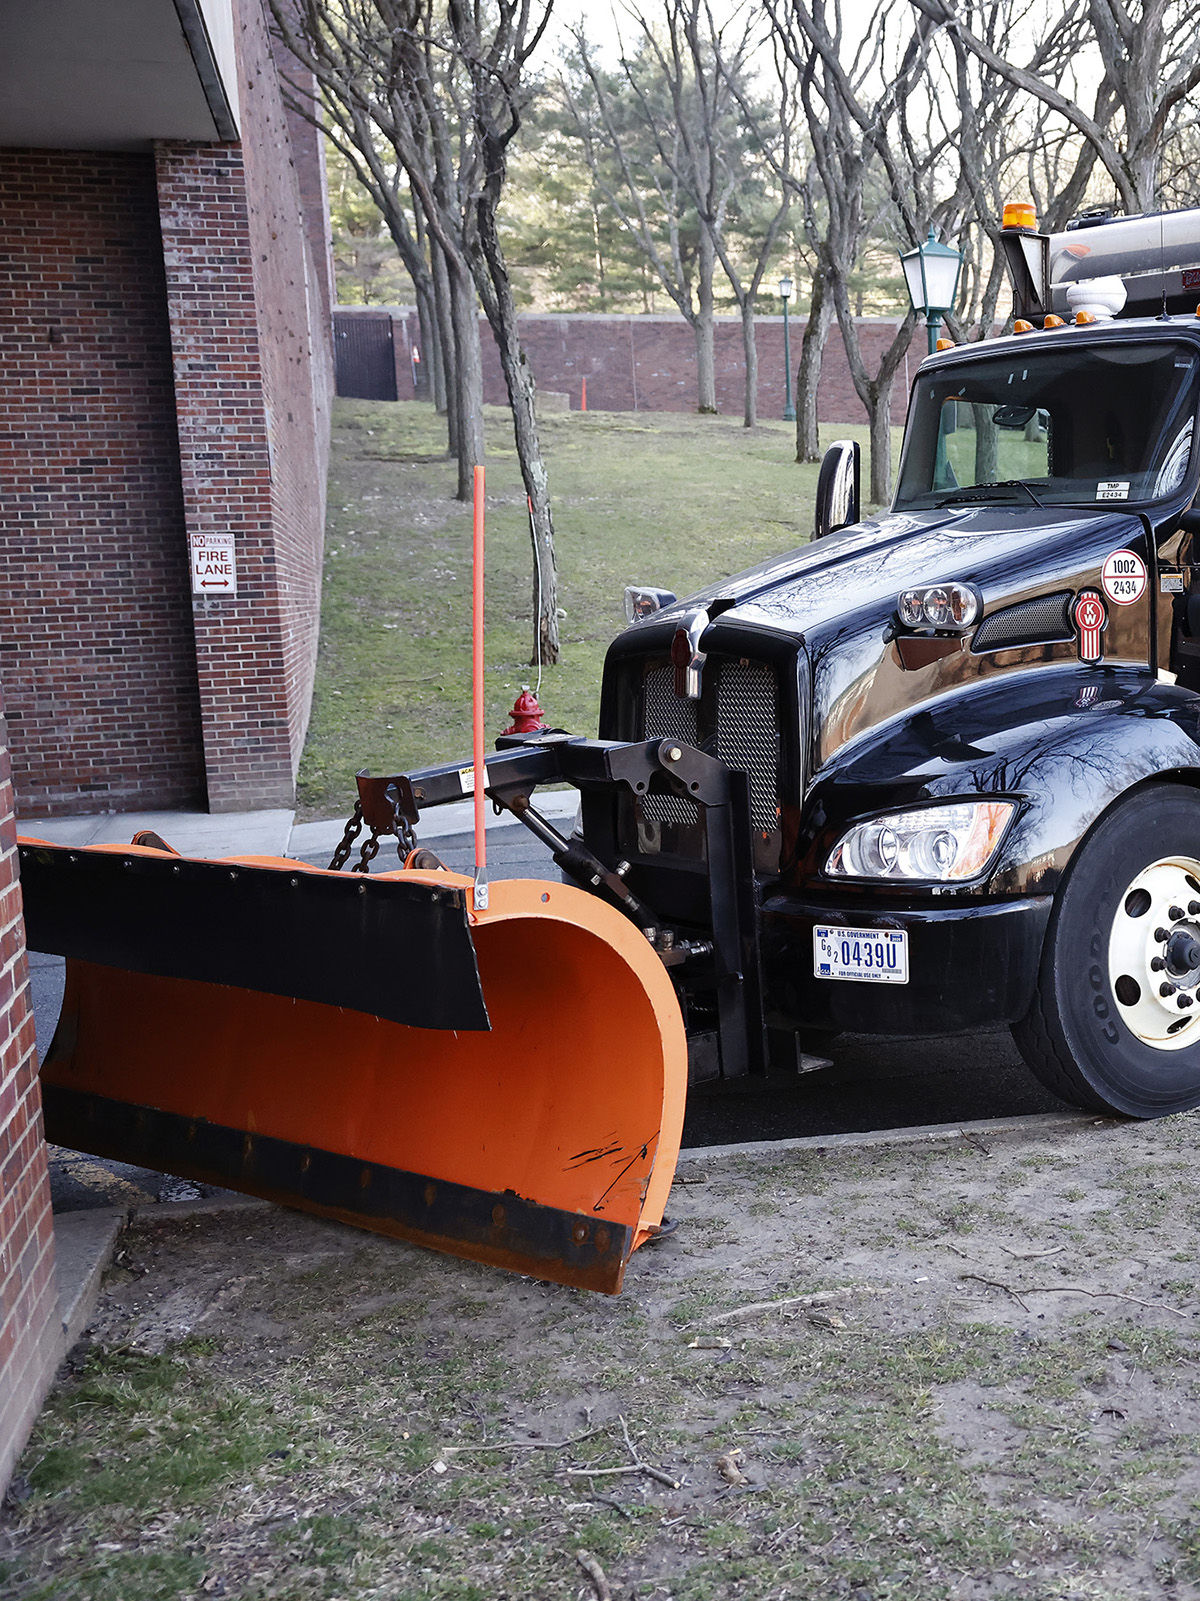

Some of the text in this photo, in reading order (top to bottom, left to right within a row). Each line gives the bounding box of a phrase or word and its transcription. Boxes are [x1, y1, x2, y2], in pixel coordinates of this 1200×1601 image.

[193, 535, 232, 546] NO PARKING
[198, 551, 228, 561] FIRE
[195, 564, 232, 575] LANE
[1113, 560, 1136, 574] 1002
[1113, 581, 1137, 595] 2434
[837, 930, 847, 938] U.S.
[847, 931, 879, 940] GOVERNMENT
[841, 940, 896, 968] 0439U
